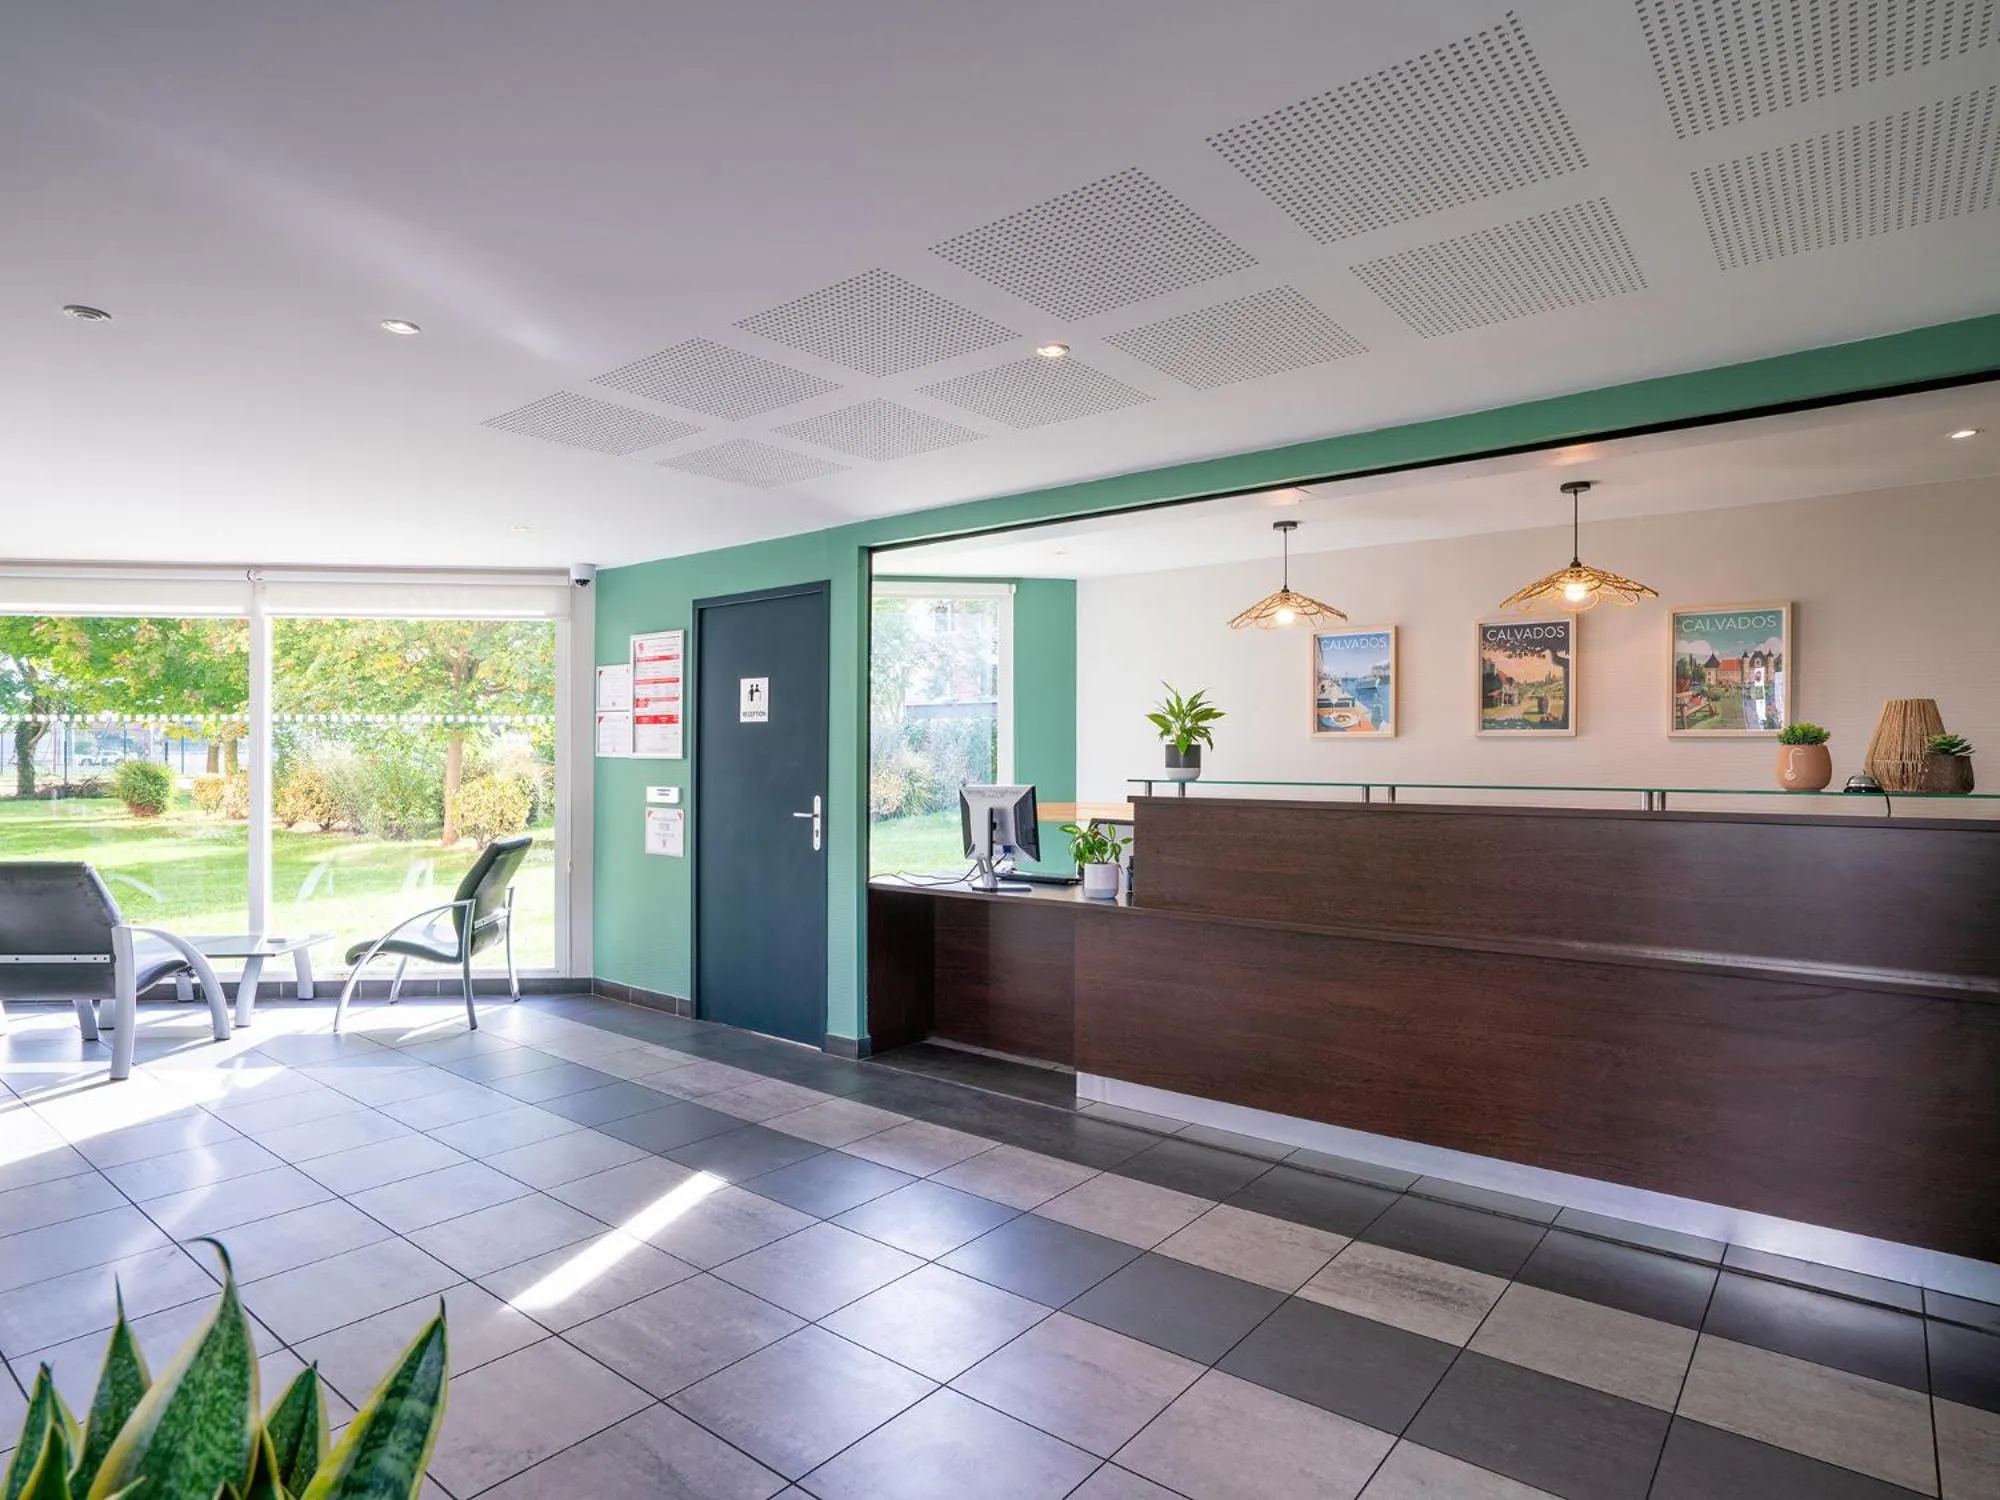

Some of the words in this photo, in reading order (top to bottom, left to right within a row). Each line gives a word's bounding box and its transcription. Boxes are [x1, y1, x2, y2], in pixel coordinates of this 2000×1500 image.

[1681, 615, 1777, 633] CALVADOS
[1486, 626, 1565, 641] CALVADOS
[1321, 637, 1387, 650] CALVADOS
